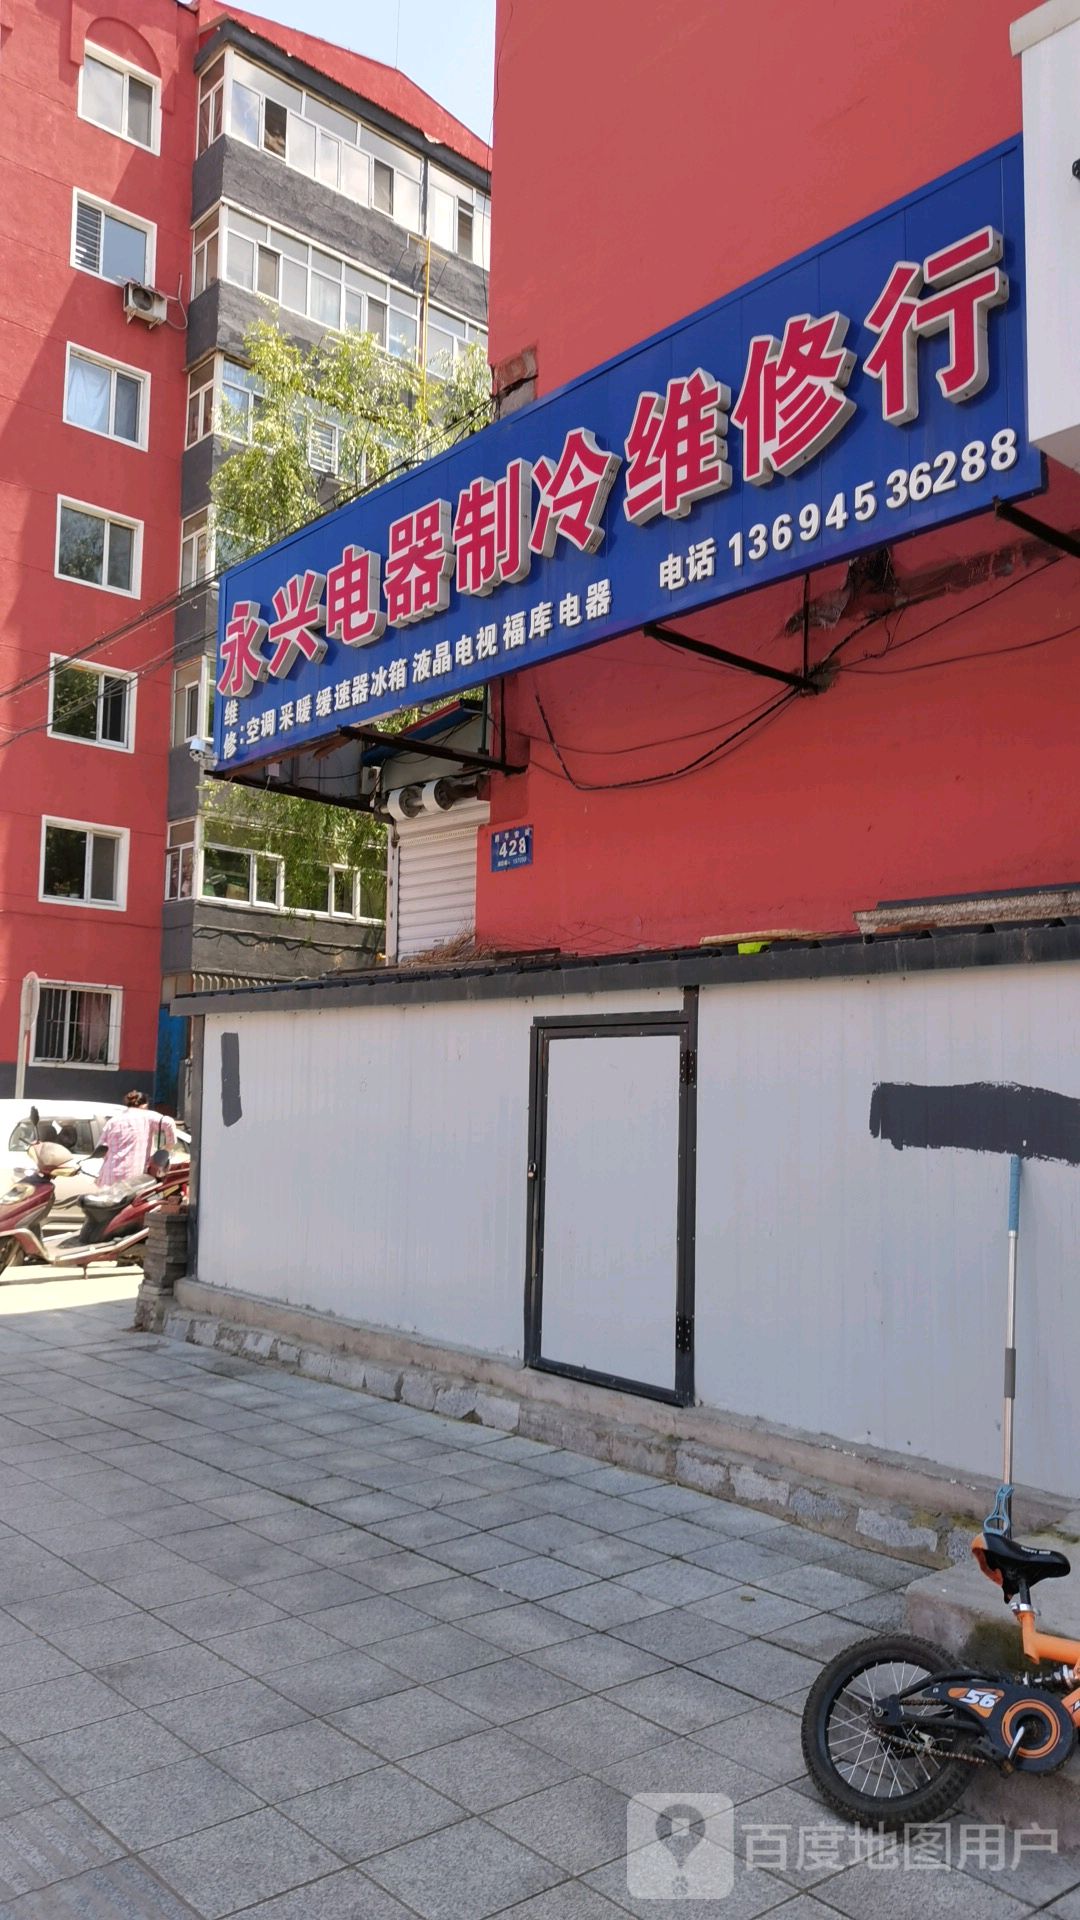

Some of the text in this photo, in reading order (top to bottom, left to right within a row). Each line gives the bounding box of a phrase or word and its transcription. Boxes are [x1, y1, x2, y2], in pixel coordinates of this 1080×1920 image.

[216, 225, 1009, 697] 永兴电器制冷维修行
[658, 428, 1018, 591] 电话 13694536288
[498, 836, 527, 858] 428
[958, 1688, 999, 1709] 56
